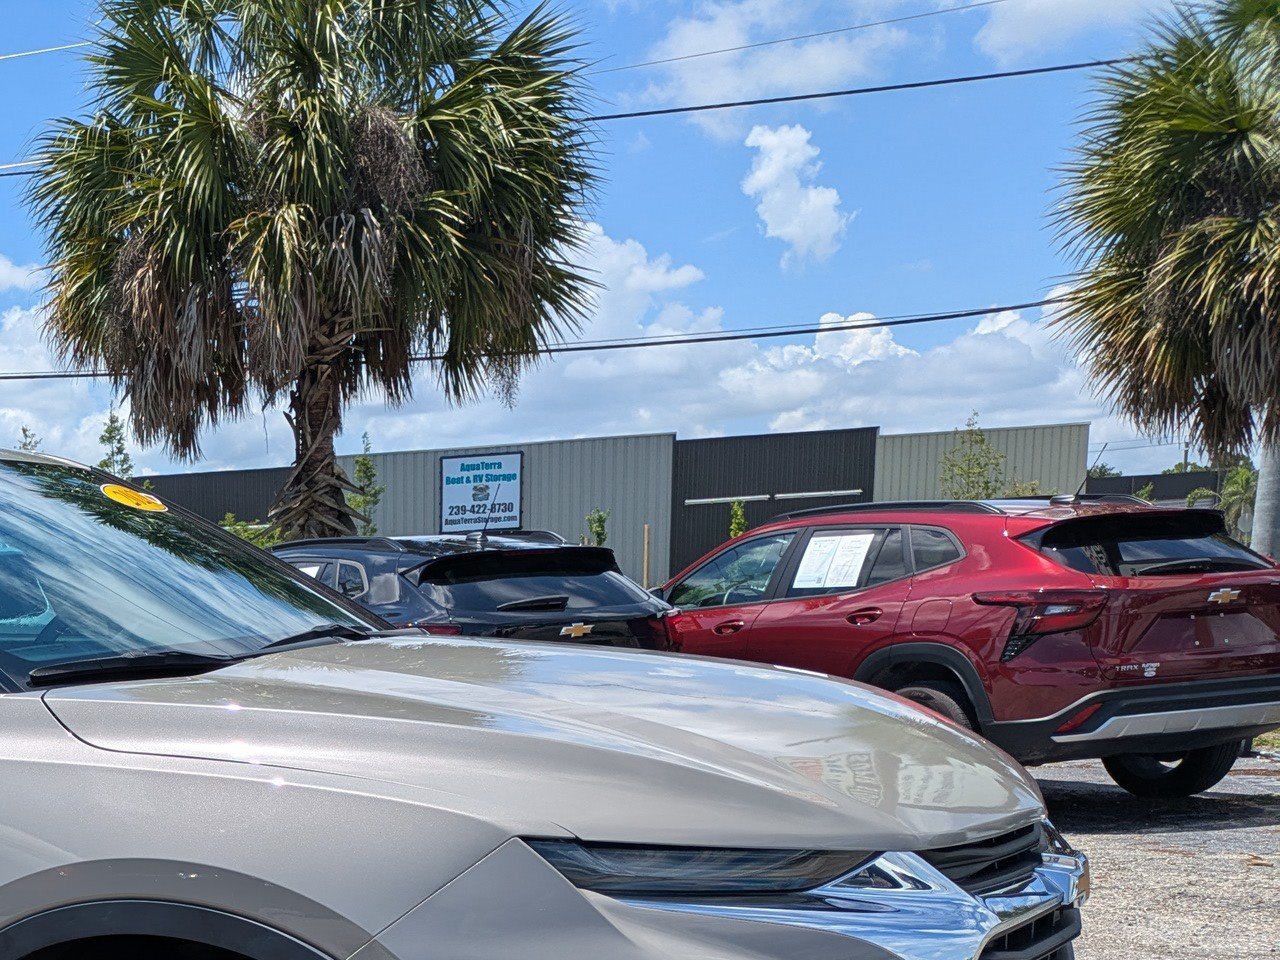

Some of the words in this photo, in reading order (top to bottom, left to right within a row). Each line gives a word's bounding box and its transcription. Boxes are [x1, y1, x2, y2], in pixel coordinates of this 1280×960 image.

[460, 461, 502, 473] AquaTerra
[445, 476, 464, 485] Boat
[465, 476, 472, 484] &
[473, 474, 483, 483] RV
[484, 473, 517, 483] Storage
[448, 502, 514, 516] 239-422-8730
[444, 515, 518, 526] AquaTerraStorage.com
[1115, 664, 1139, 672] TRAX
